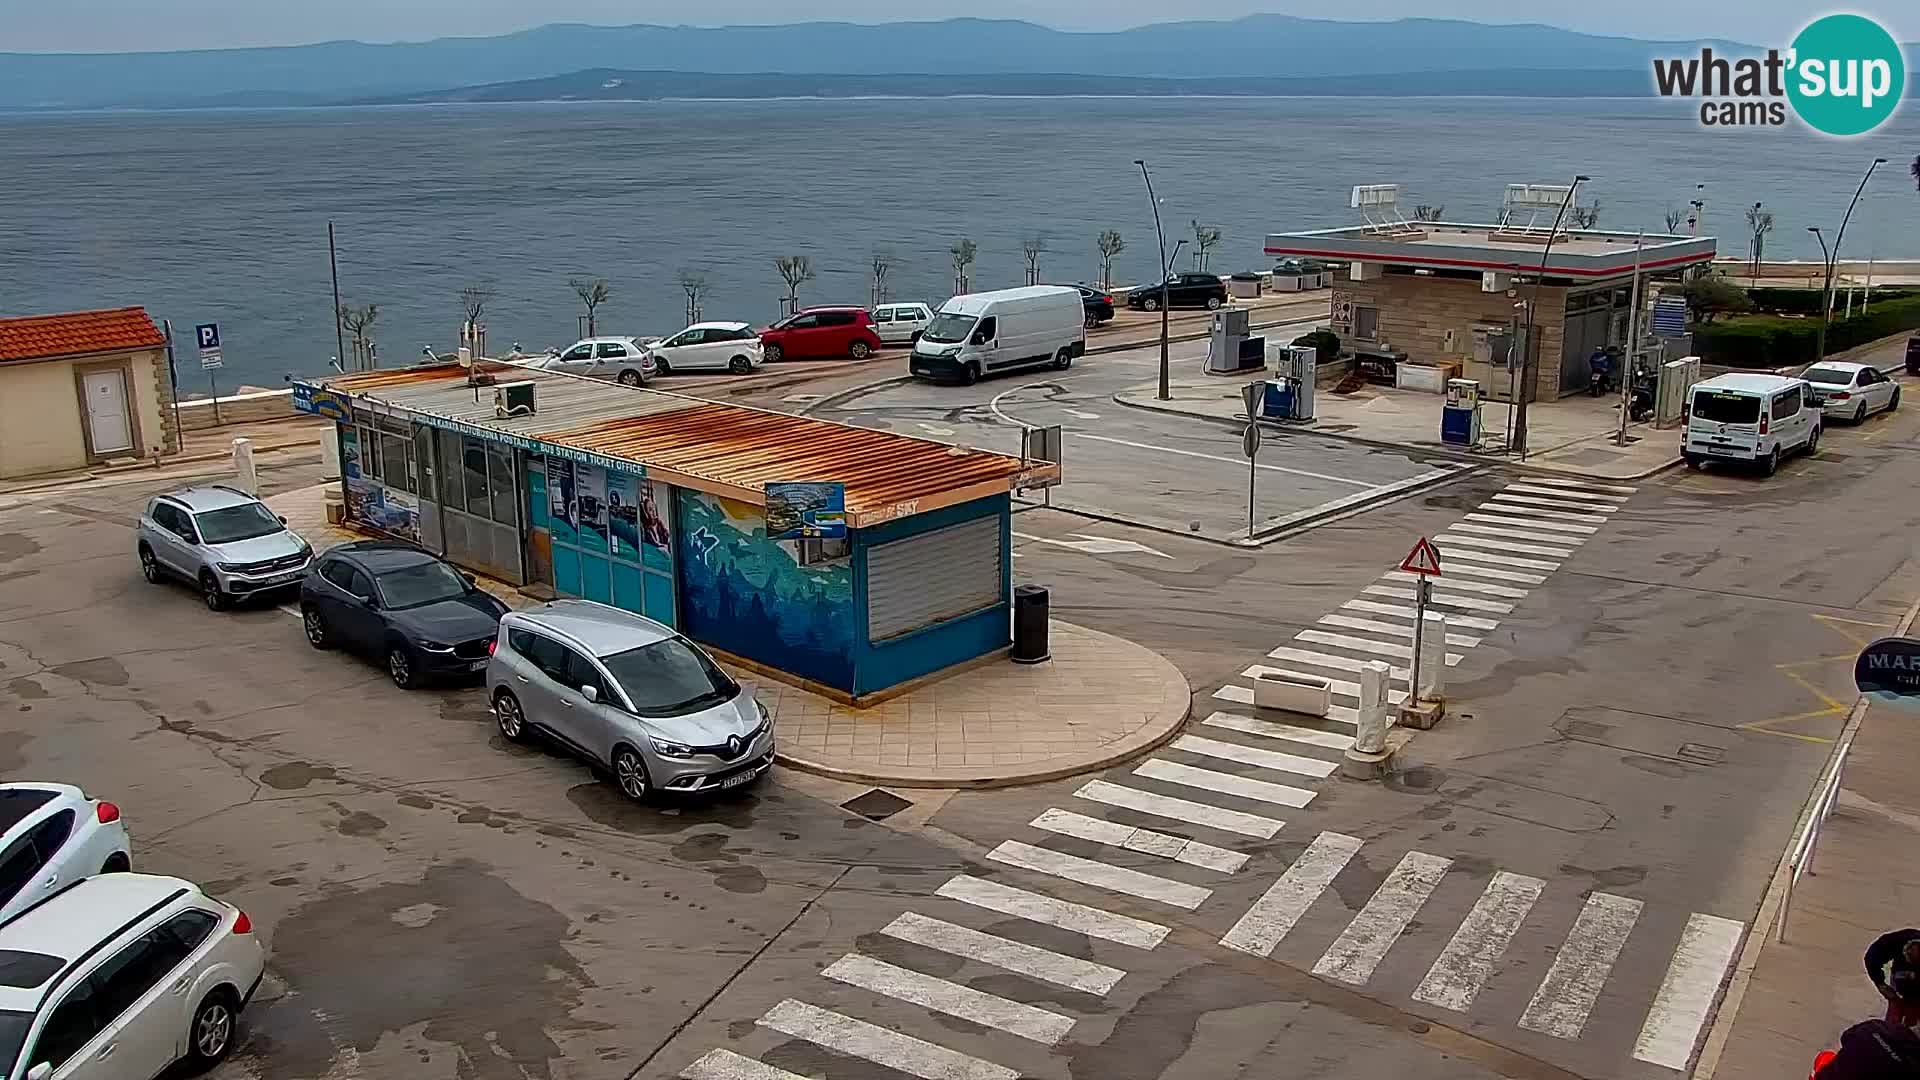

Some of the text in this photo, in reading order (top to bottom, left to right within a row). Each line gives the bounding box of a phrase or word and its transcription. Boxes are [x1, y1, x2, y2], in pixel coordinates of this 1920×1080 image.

[202, 327, 214, 346] P
[459, 422, 498, 441] AUTOBUSNA
[500, 434, 530, 448] POSTAJA
[540, 444, 643, 475] BUS STATION TICKET OFFICE
